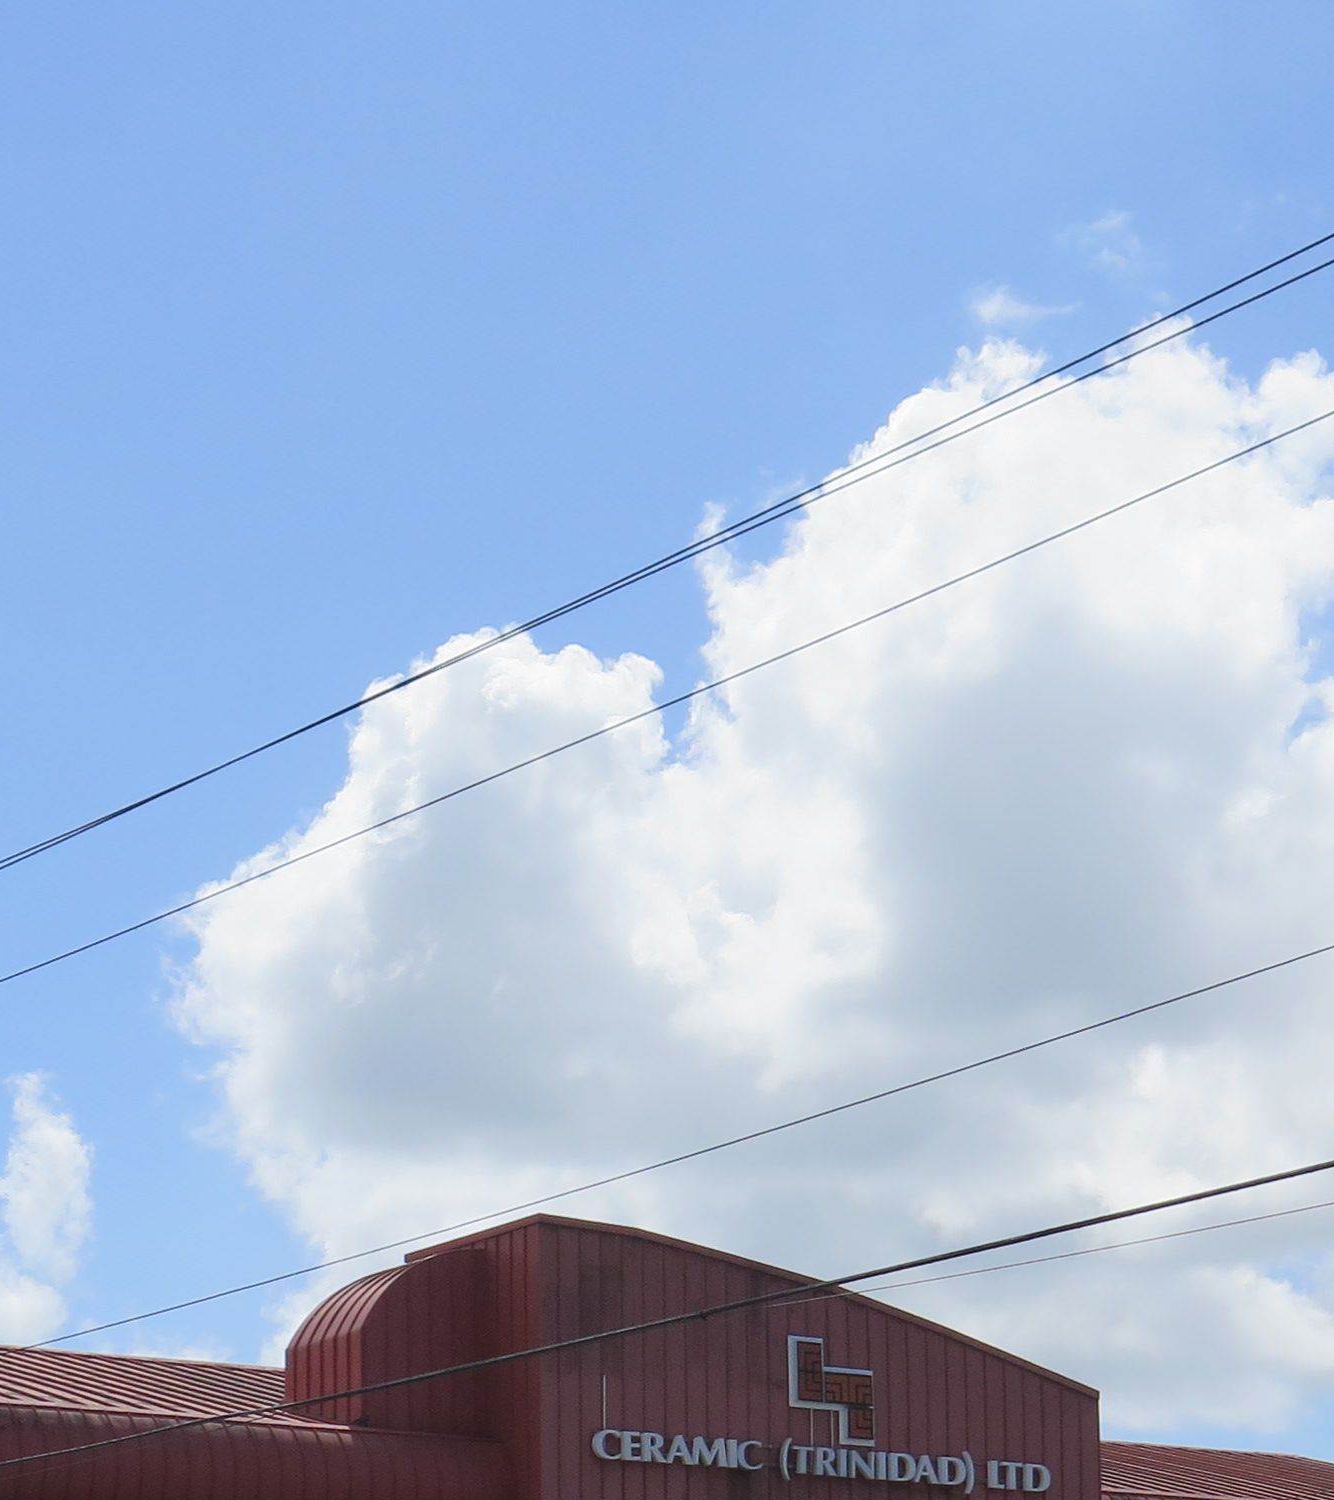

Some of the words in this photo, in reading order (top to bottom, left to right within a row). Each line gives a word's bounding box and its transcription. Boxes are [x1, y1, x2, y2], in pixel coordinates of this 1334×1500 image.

[591, 1429, 764, 1471] CERAMIC
[780, 1437, 974, 1494] (TRINIDAD)
[987, 1459, 1052, 1493] LTD
